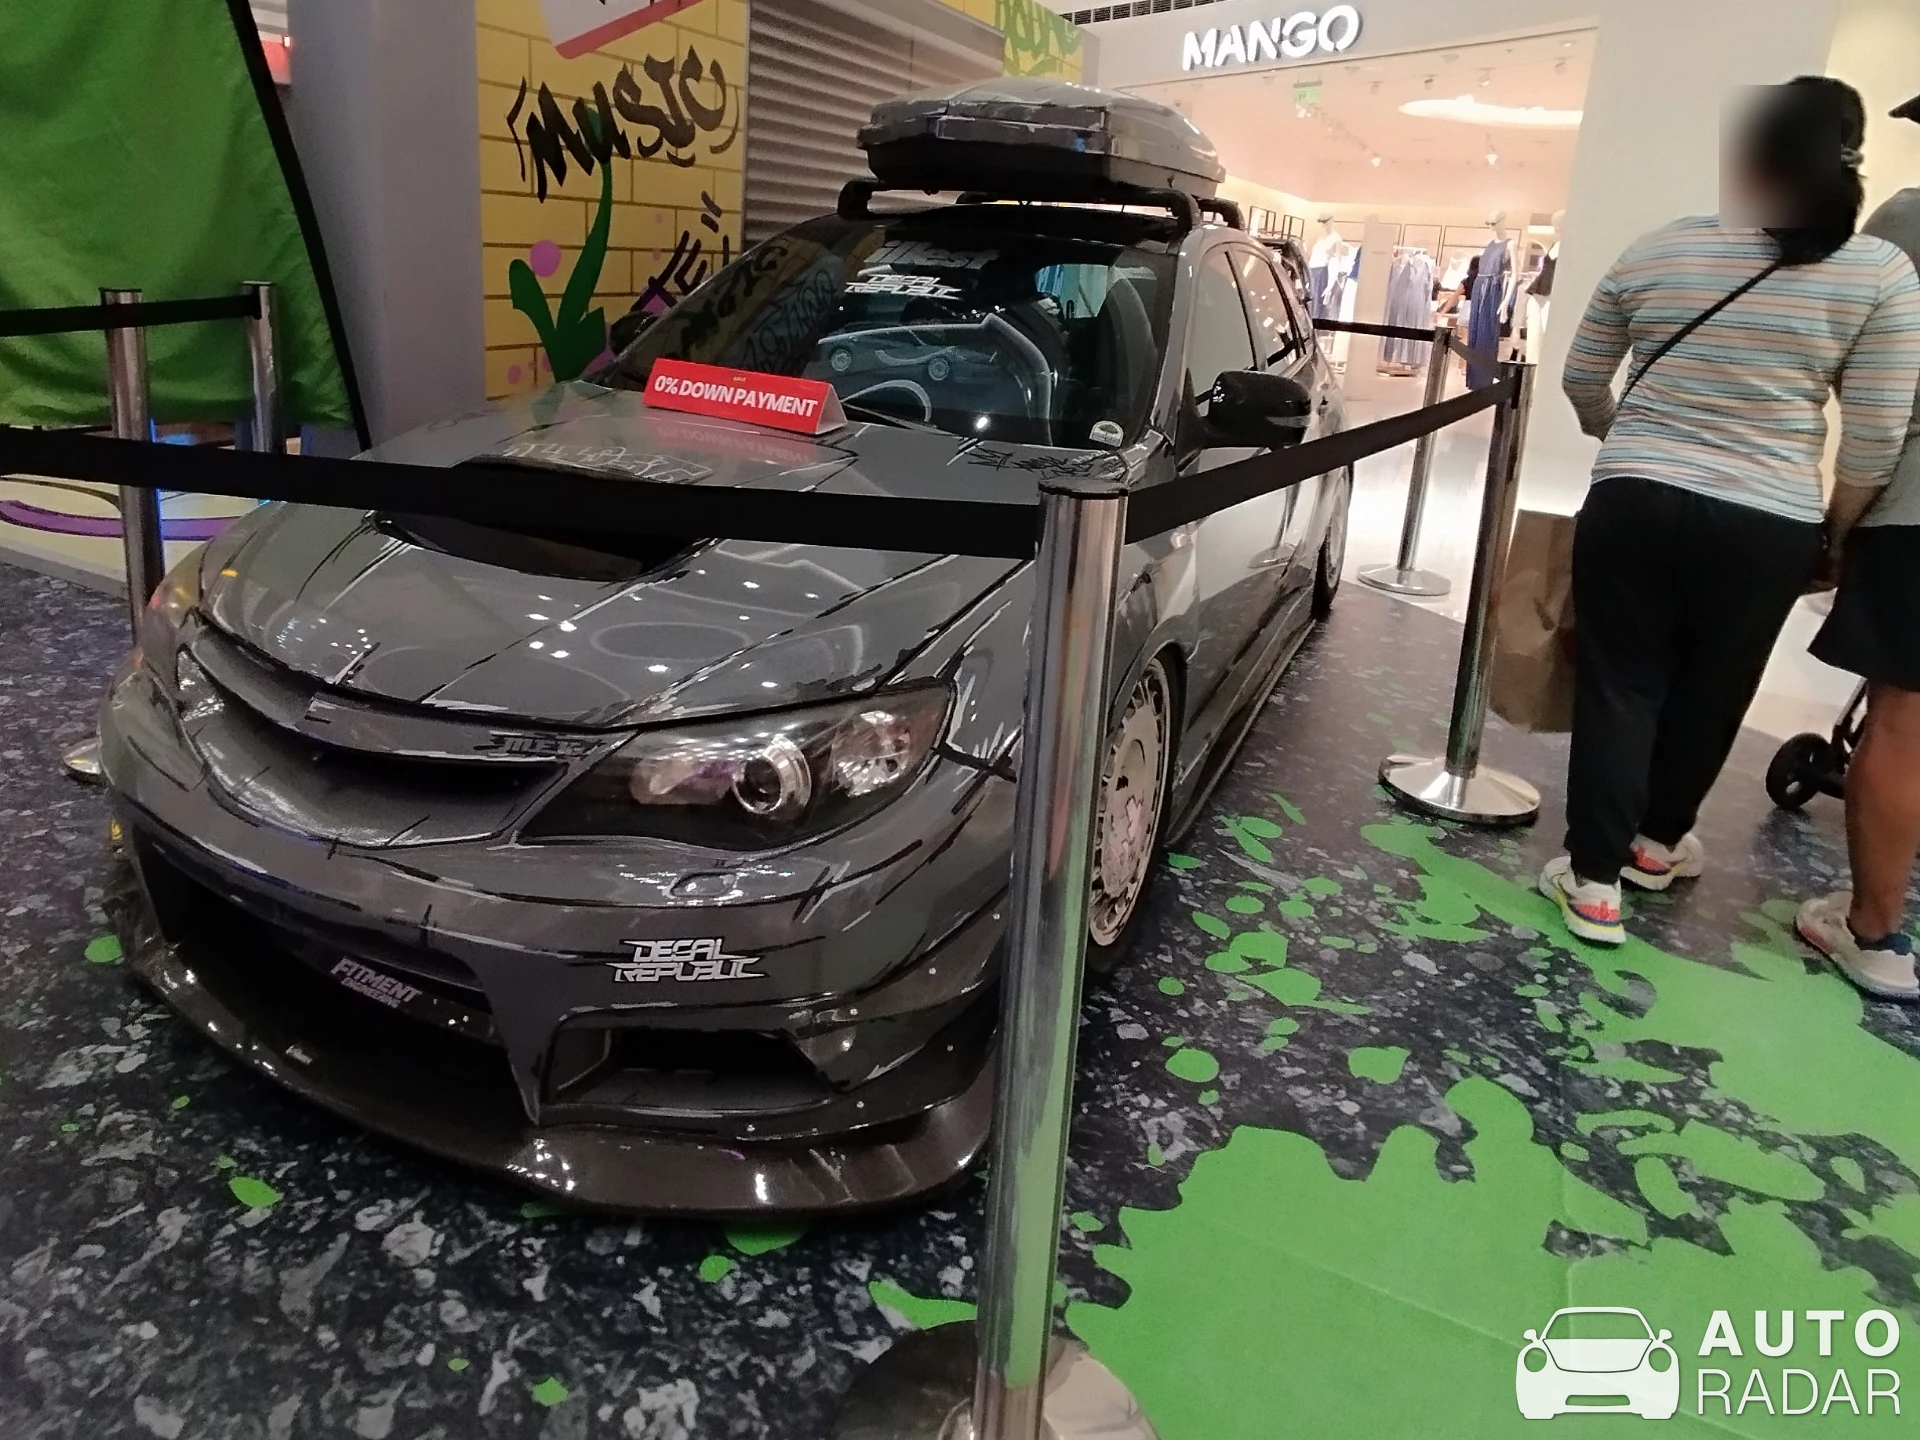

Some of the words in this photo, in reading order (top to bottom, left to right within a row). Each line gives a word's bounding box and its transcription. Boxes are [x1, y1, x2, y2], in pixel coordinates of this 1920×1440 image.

[1182, 5, 1363, 71] MANGO
[526, 45, 728, 204] MUSIC
[654, 375, 680, 395] 0%
[679, 380, 735, 405] DOWN
[733, 390, 819, 418] PAYMENT
[605, 956, 766, 982] REPUBLIC
[624, 938, 749, 963] DECAL
[330, 957, 423, 1003] FITMENT
